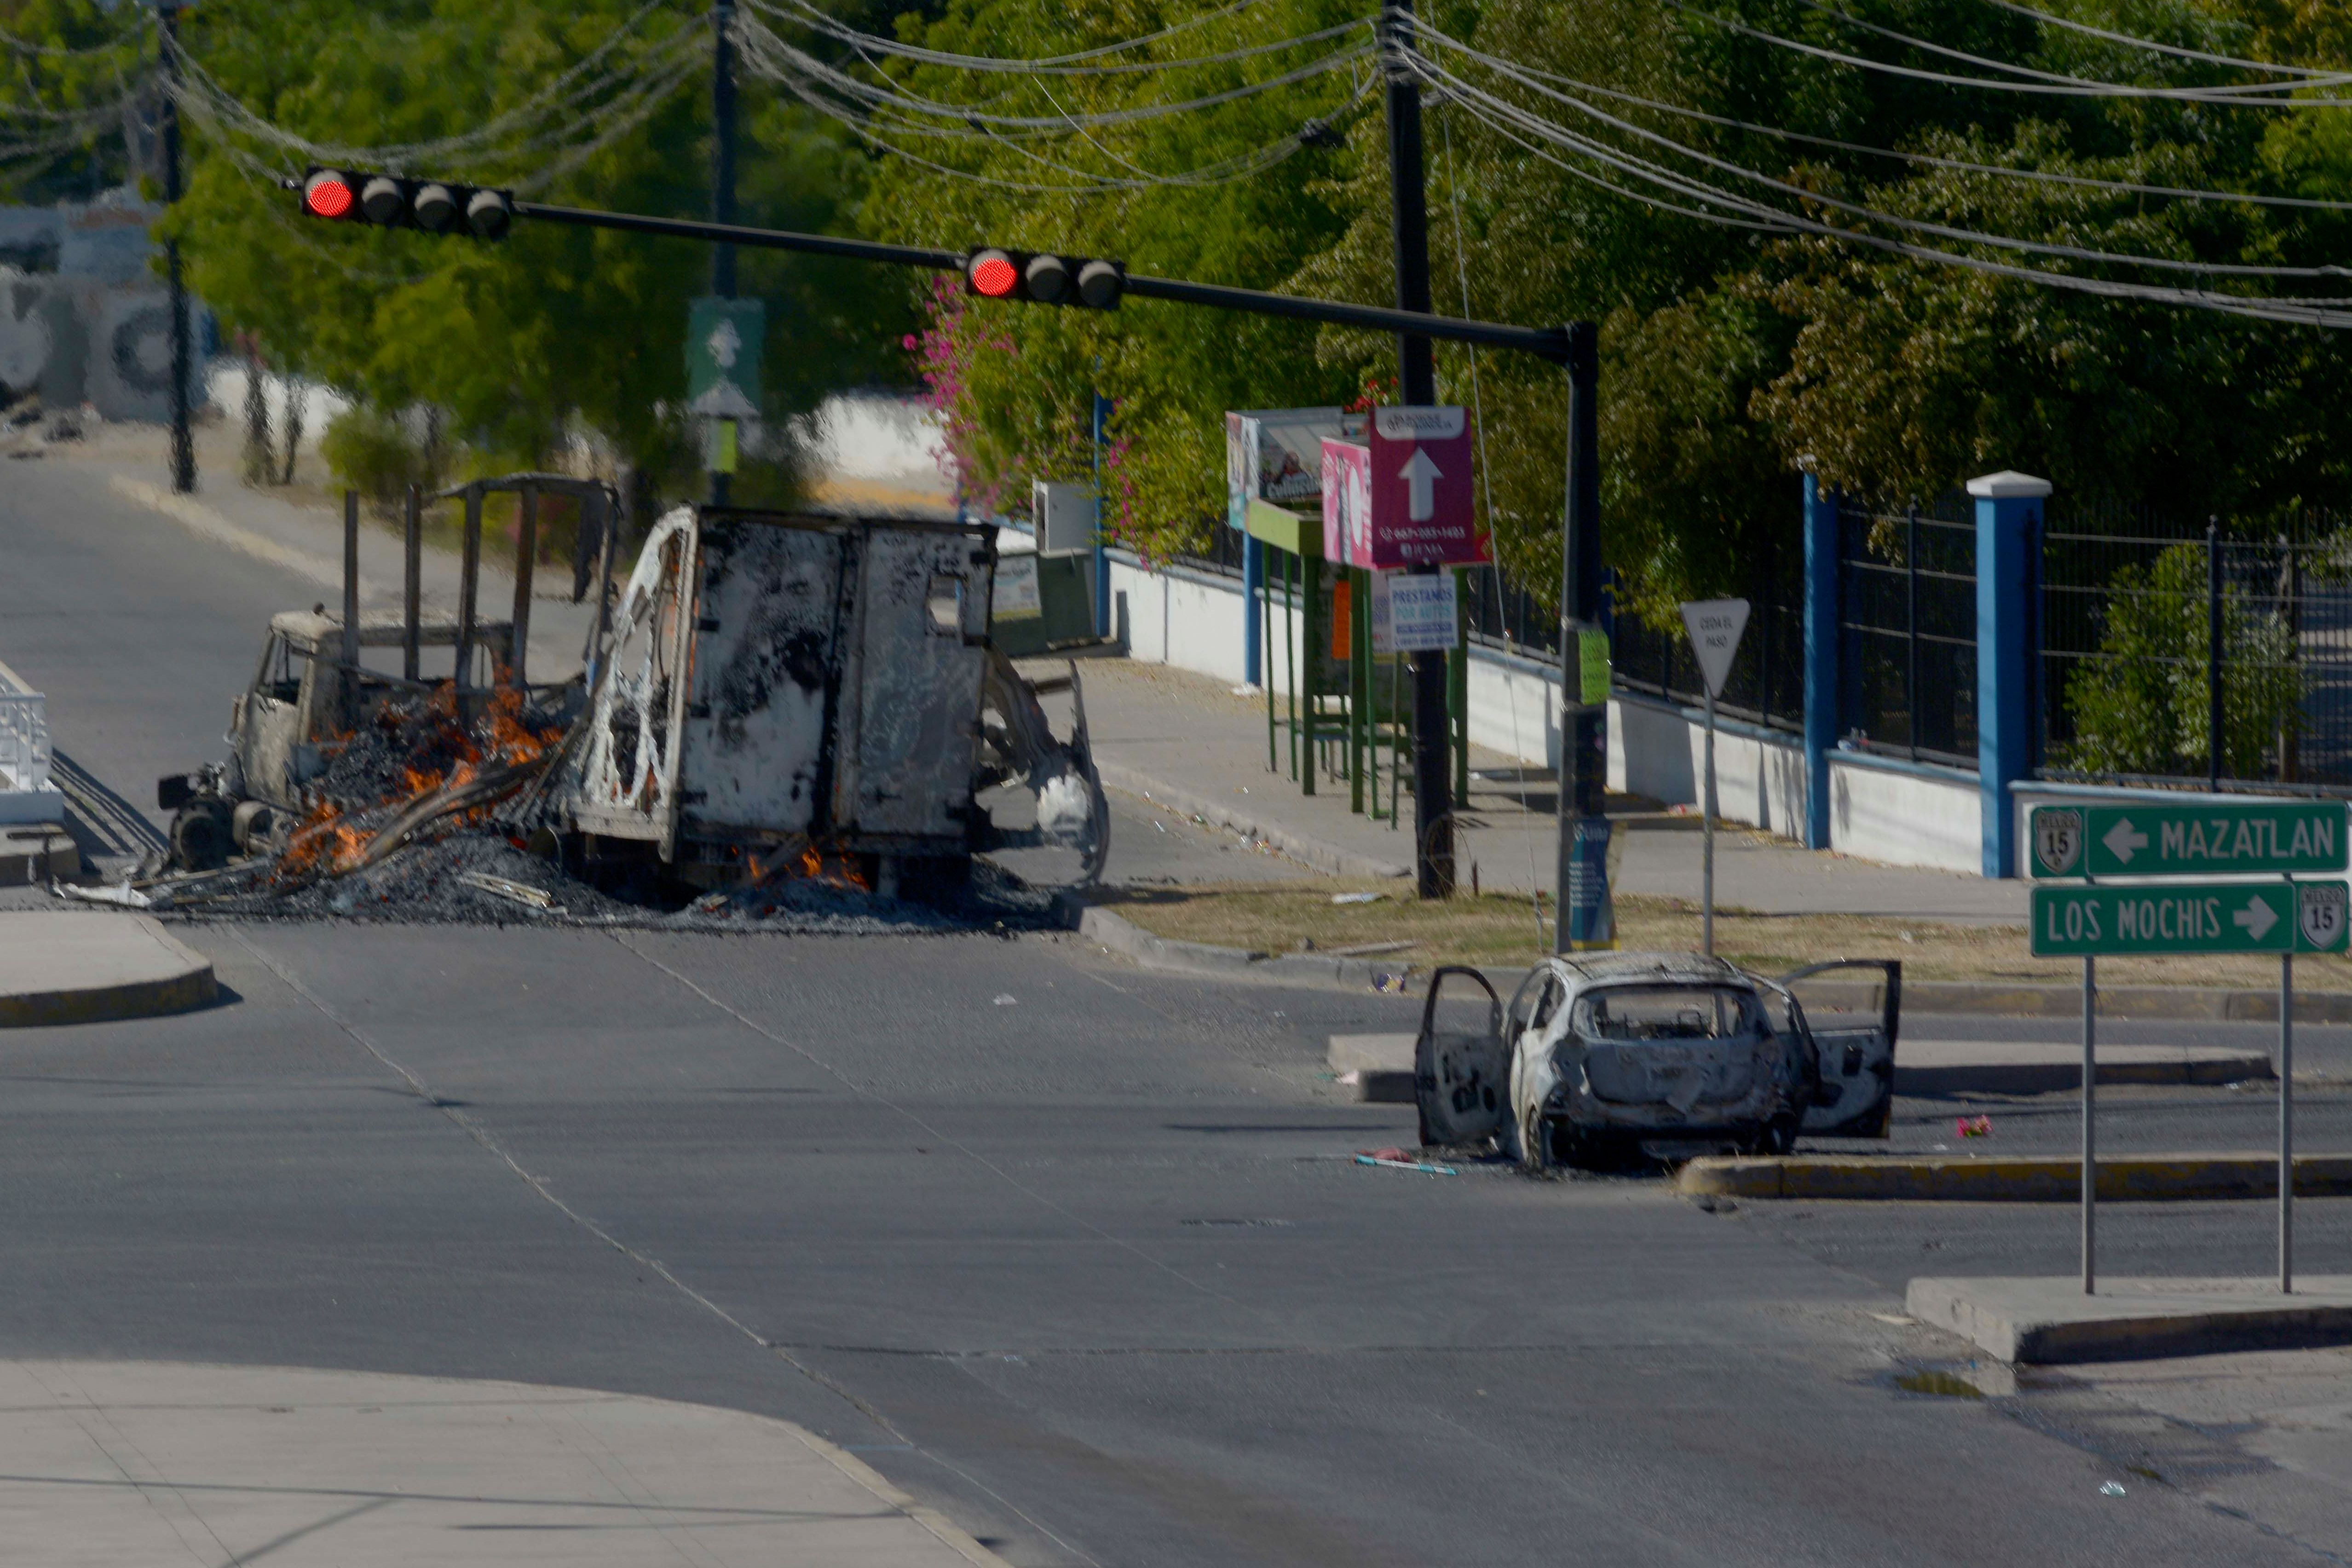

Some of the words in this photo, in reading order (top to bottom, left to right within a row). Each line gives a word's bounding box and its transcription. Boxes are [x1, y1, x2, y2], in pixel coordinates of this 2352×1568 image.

[1700, 617, 1722, 630] CEDA
[1706, 635, 1727, 648] PASO
[2047, 831, 2069, 854] 15
[2161, 817, 2334, 860] MAZATLAN
[2048, 899, 2102, 942] LOS
[2118, 897, 2222, 941] MOCHIS
[2312, 905, 2334, 930] 15
